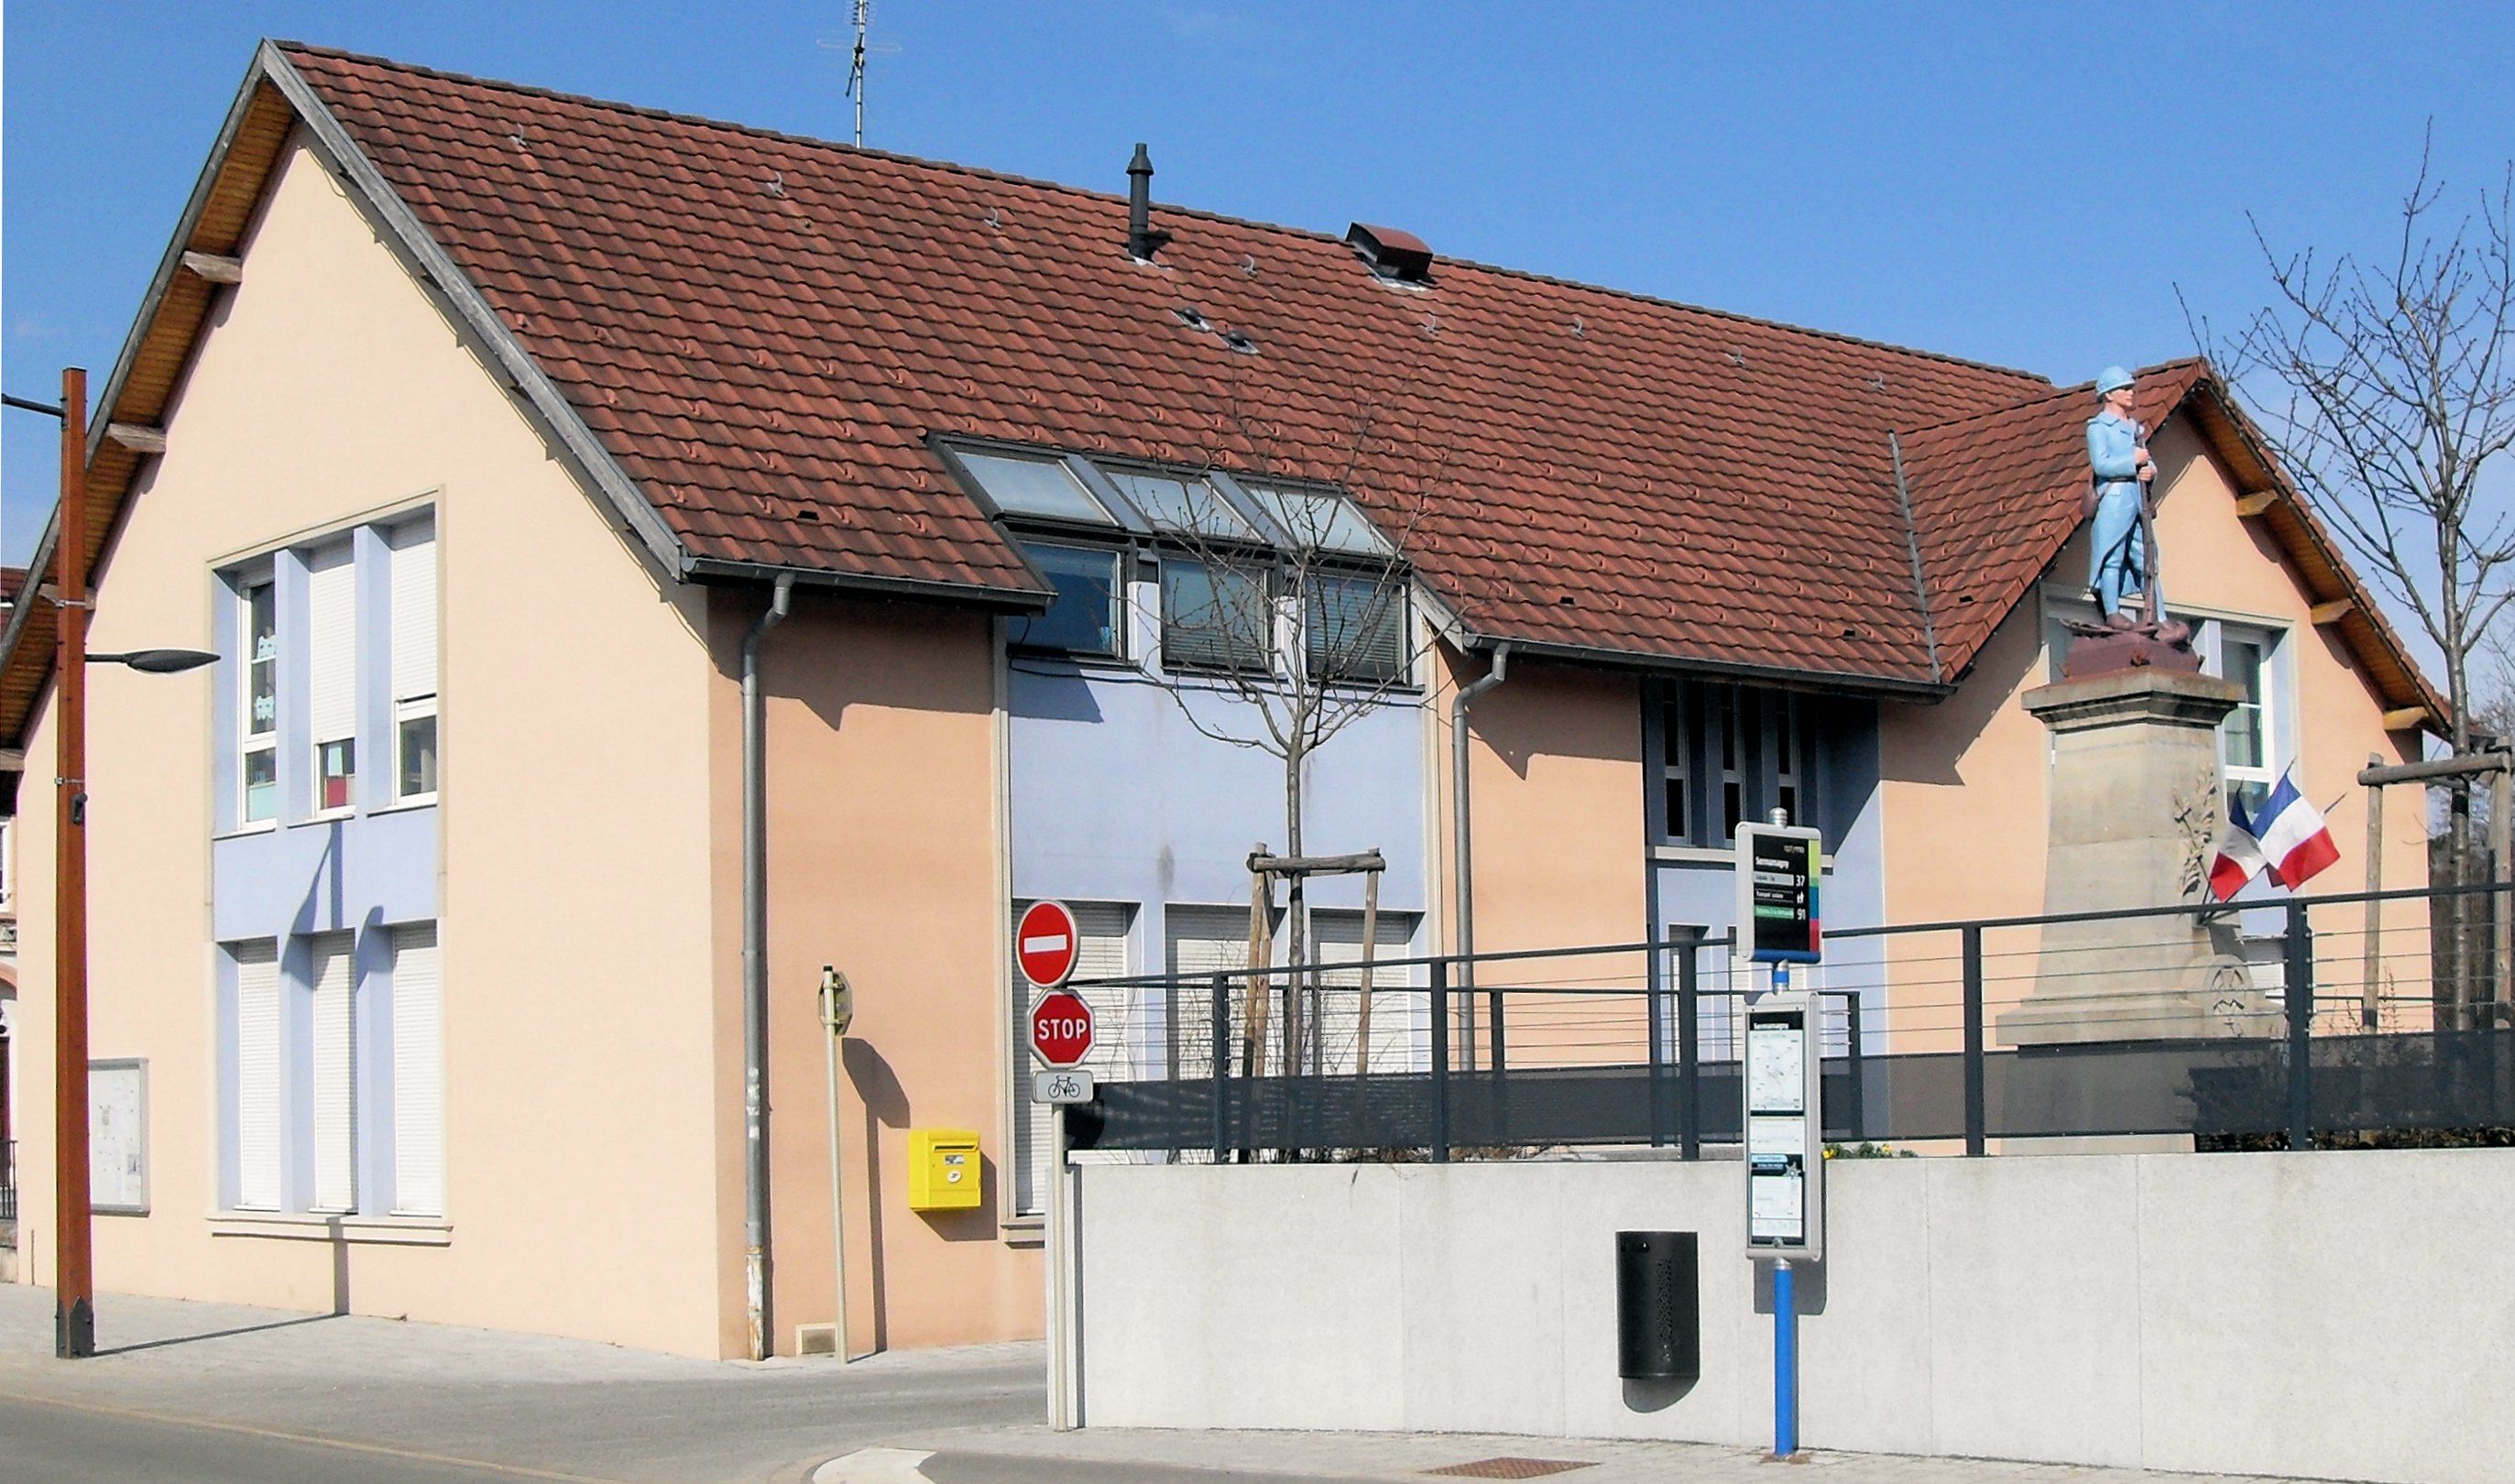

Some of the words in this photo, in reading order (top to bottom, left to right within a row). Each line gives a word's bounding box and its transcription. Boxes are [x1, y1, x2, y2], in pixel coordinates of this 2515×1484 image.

[1796, 874, 1806, 887] 37
[1797, 908, 1806, 921] 91
[1037, 1018, 1088, 1041] STOP
